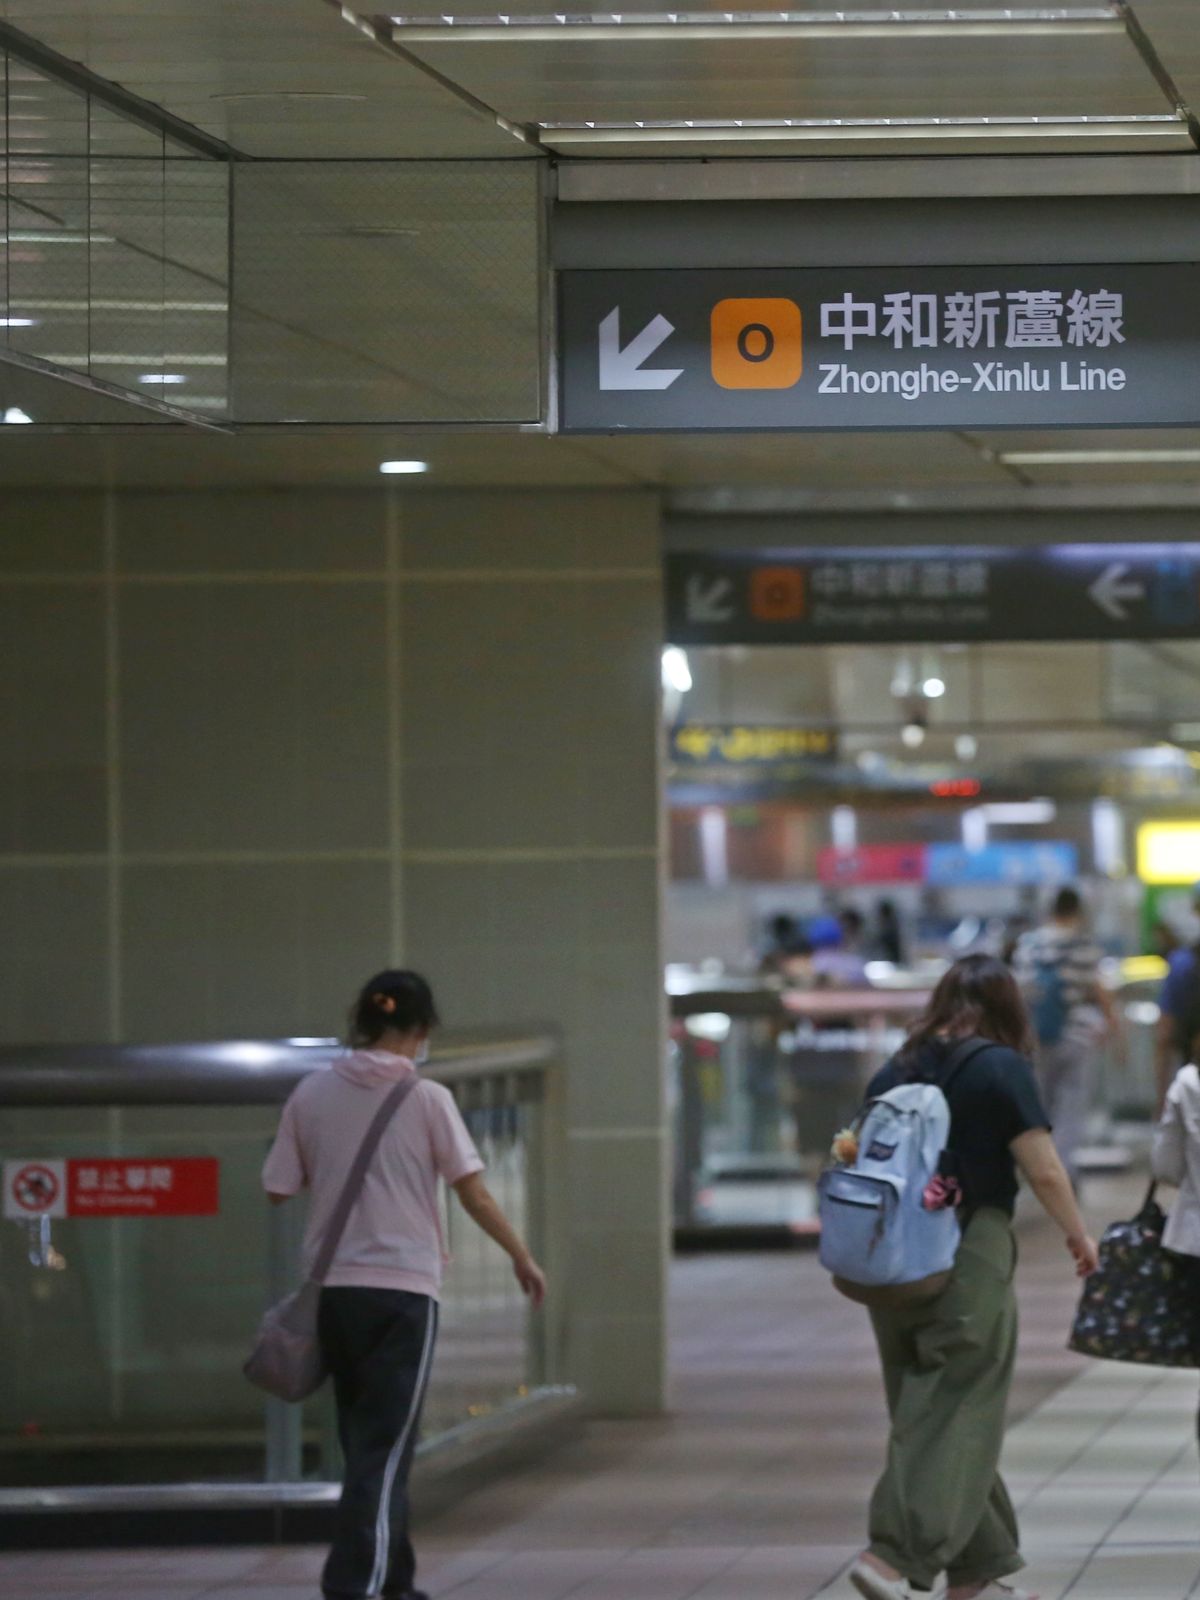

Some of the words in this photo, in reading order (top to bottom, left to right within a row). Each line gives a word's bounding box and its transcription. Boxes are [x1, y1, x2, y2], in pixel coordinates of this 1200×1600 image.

[819, 289, 1127, 351] 中和新蘆線
[737, 323, 775, 363] O
[818, 363, 1051, 400] Zhonghe-Xinlu
[1060, 361, 1127, 392] Line
